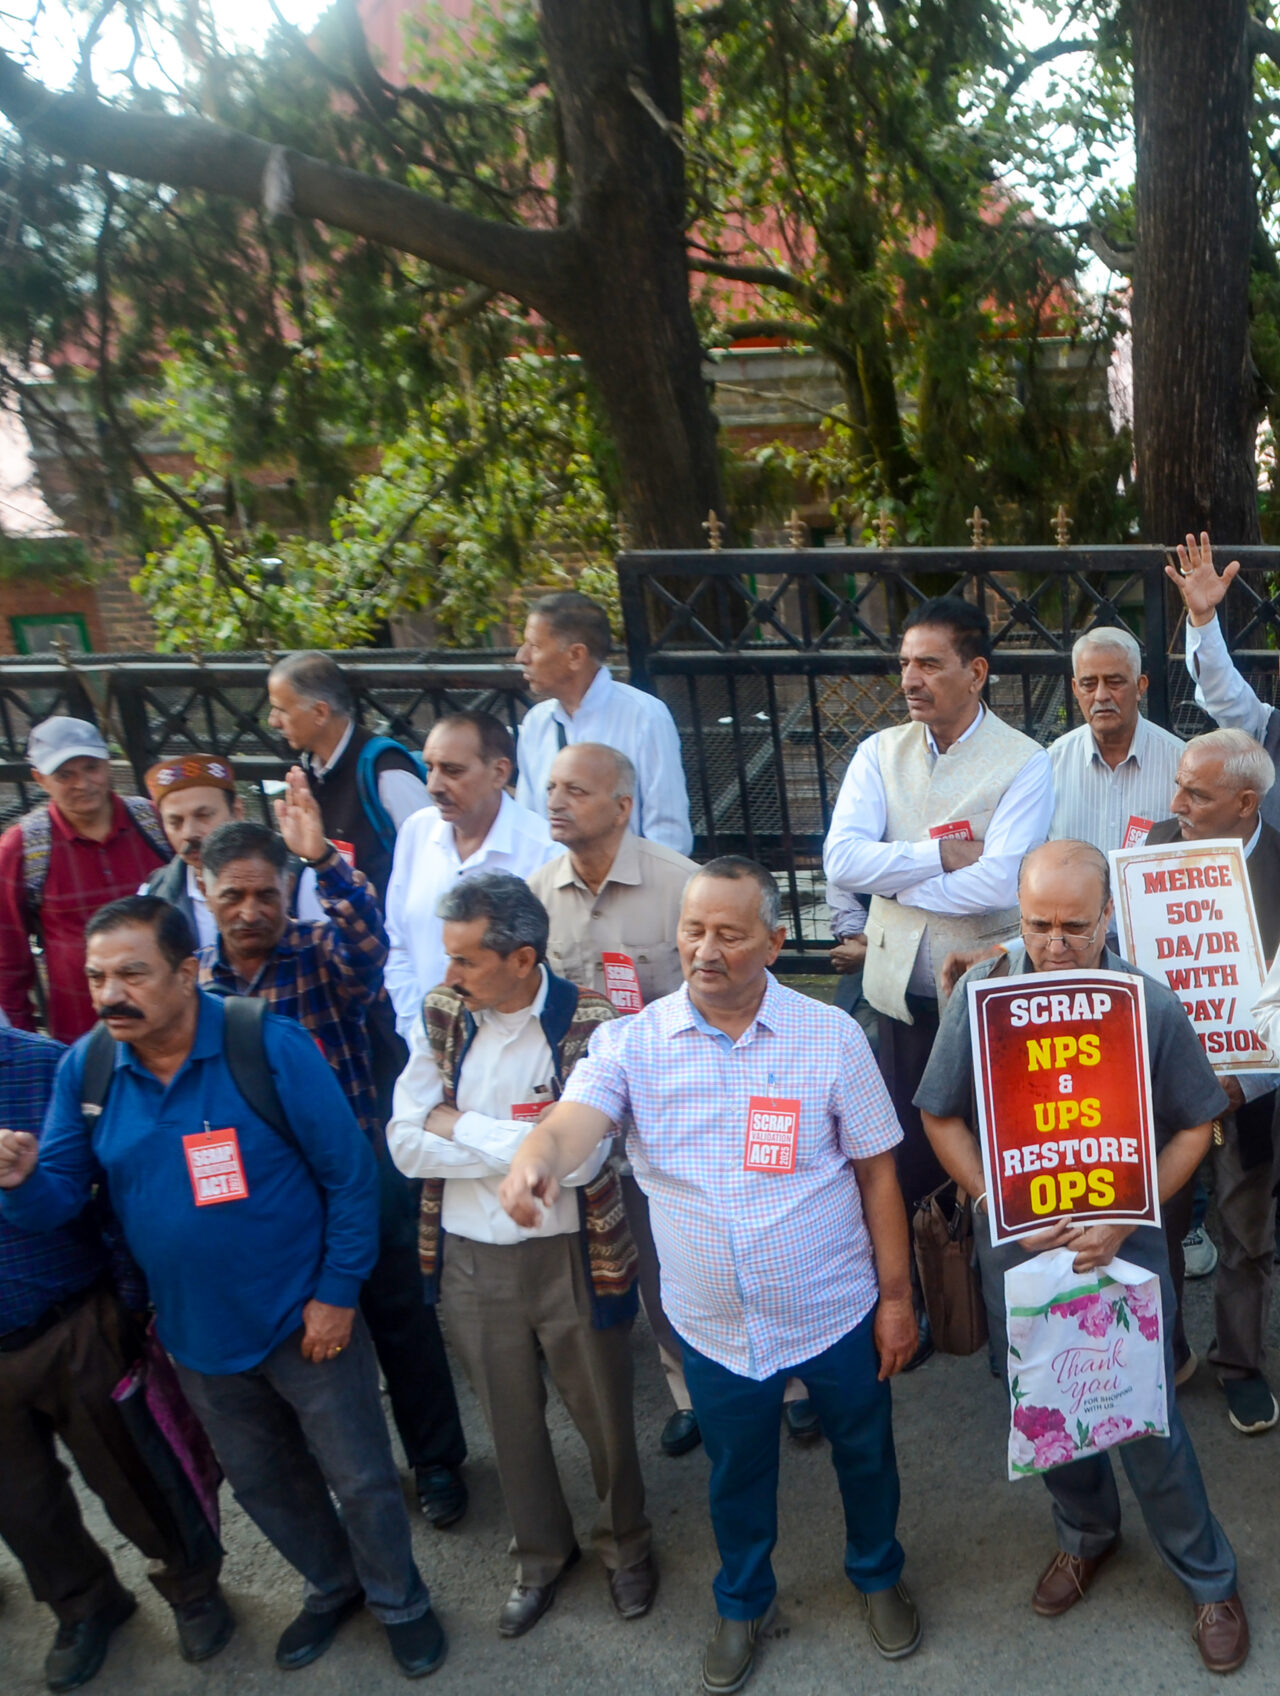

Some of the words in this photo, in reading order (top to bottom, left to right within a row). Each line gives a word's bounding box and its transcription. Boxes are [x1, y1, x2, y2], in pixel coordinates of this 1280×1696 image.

[1143, 865, 1232, 894] MERGE
[1166, 899, 1223, 925] 50%
[1155, 931, 1240, 960] DA/DR
[1165, 964, 1239, 991] WITH
[611, 990, 632, 1006] ACT
[1010, 993, 1111, 1027] SCRAP
[1026, 1034, 1101, 1072] NPS
[1059, 1074, 1073, 1093] &
[753, 1113, 793, 1132] SCRAP
[1034, 1098, 1101, 1132] UPS
[750, 1144, 779, 1165] ACT
[1003, 1137, 1139, 1177] RESTORE
[200, 1174, 230, 1197] ACT
[1030, 1168, 1115, 1215] OPS
[1051, 1338, 1129, 1384] Thank
[1061, 1375, 1119, 1414] you
[1084, 1404, 1102, 1413] WITH
